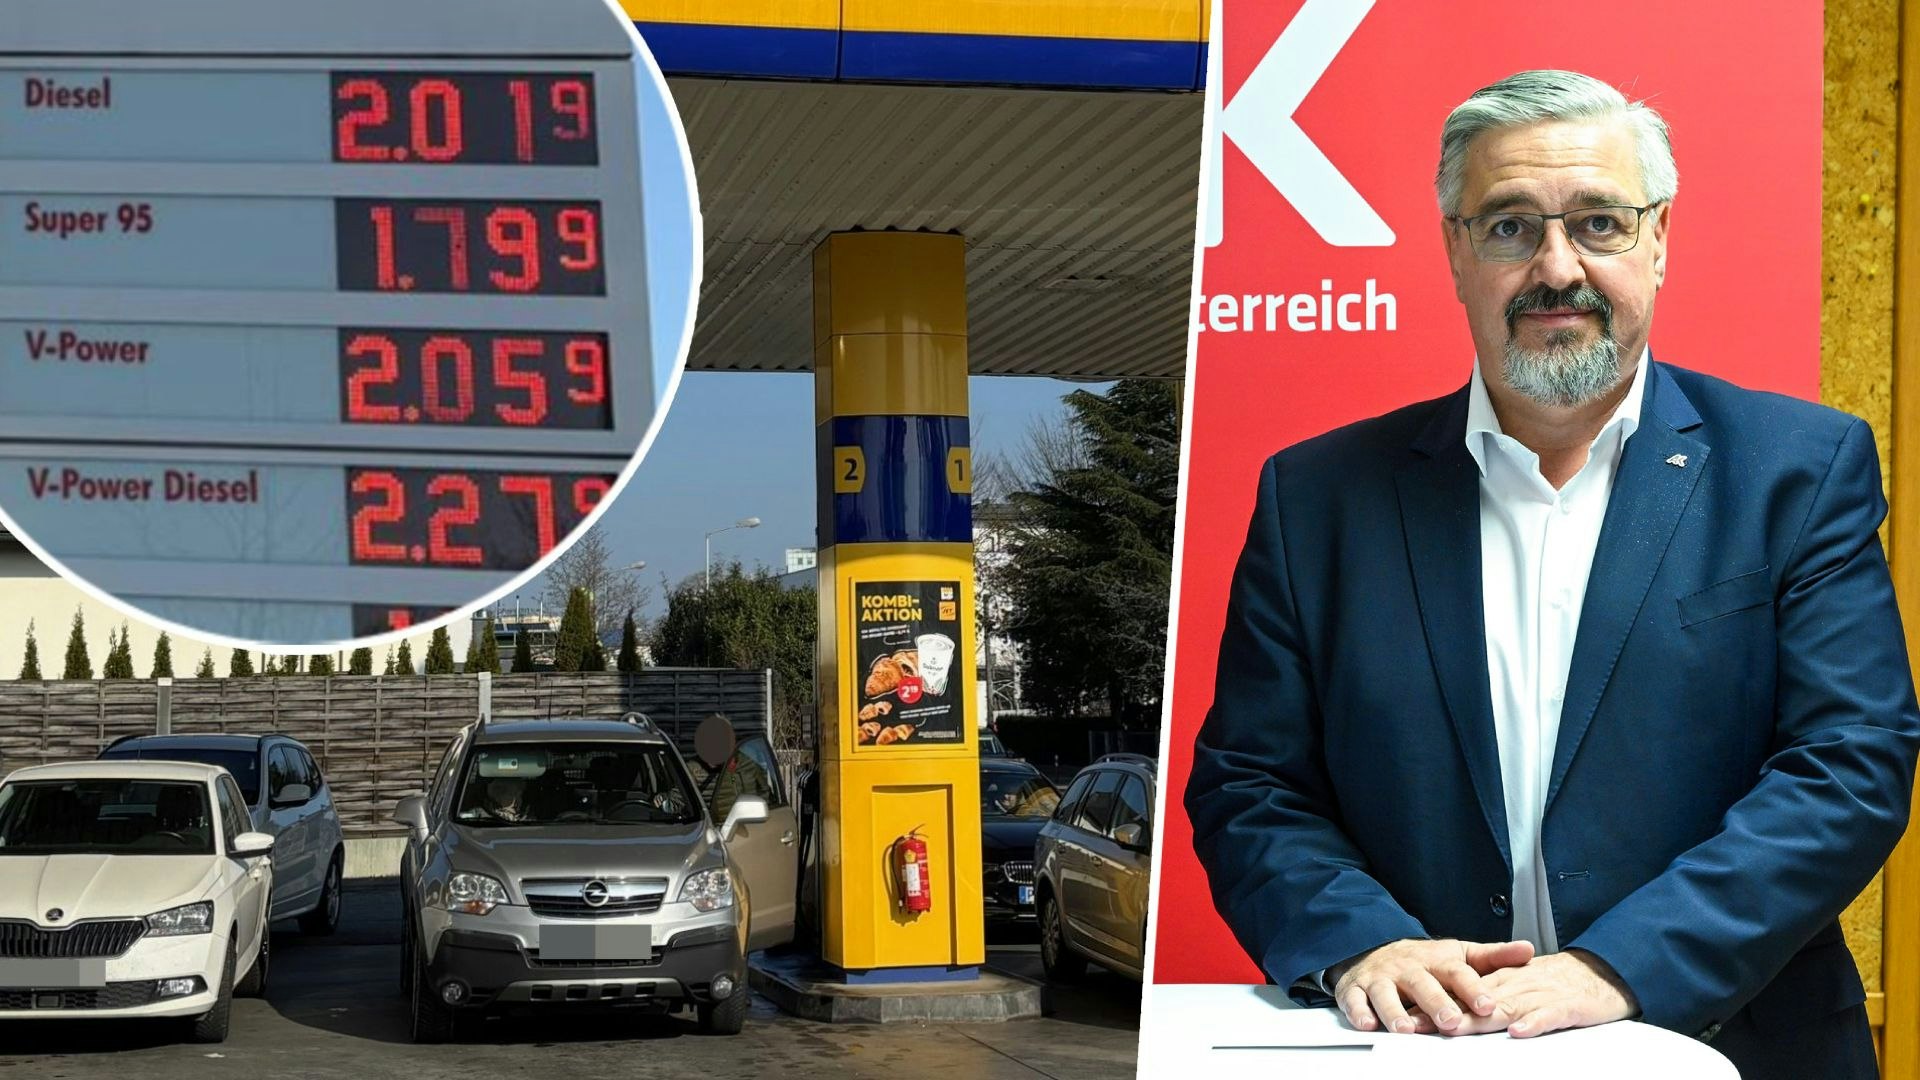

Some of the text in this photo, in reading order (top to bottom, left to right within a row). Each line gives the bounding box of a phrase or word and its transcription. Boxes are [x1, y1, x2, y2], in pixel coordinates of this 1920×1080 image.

[25, 77, 589, 161] Diesel 2.019
[25, 202, 598, 291] Super 95 1.799
[25, 330, 605, 424] V-Power 2.059
[844, 458, 859, 481] 2
[954, 459, 964, 481] 1
[28, 467, 153, 501] V-Power
[164, 468, 258, 503] Diesel
[861, 594, 920, 608] KOMBI-
[861, 608, 922, 622] AKTION
